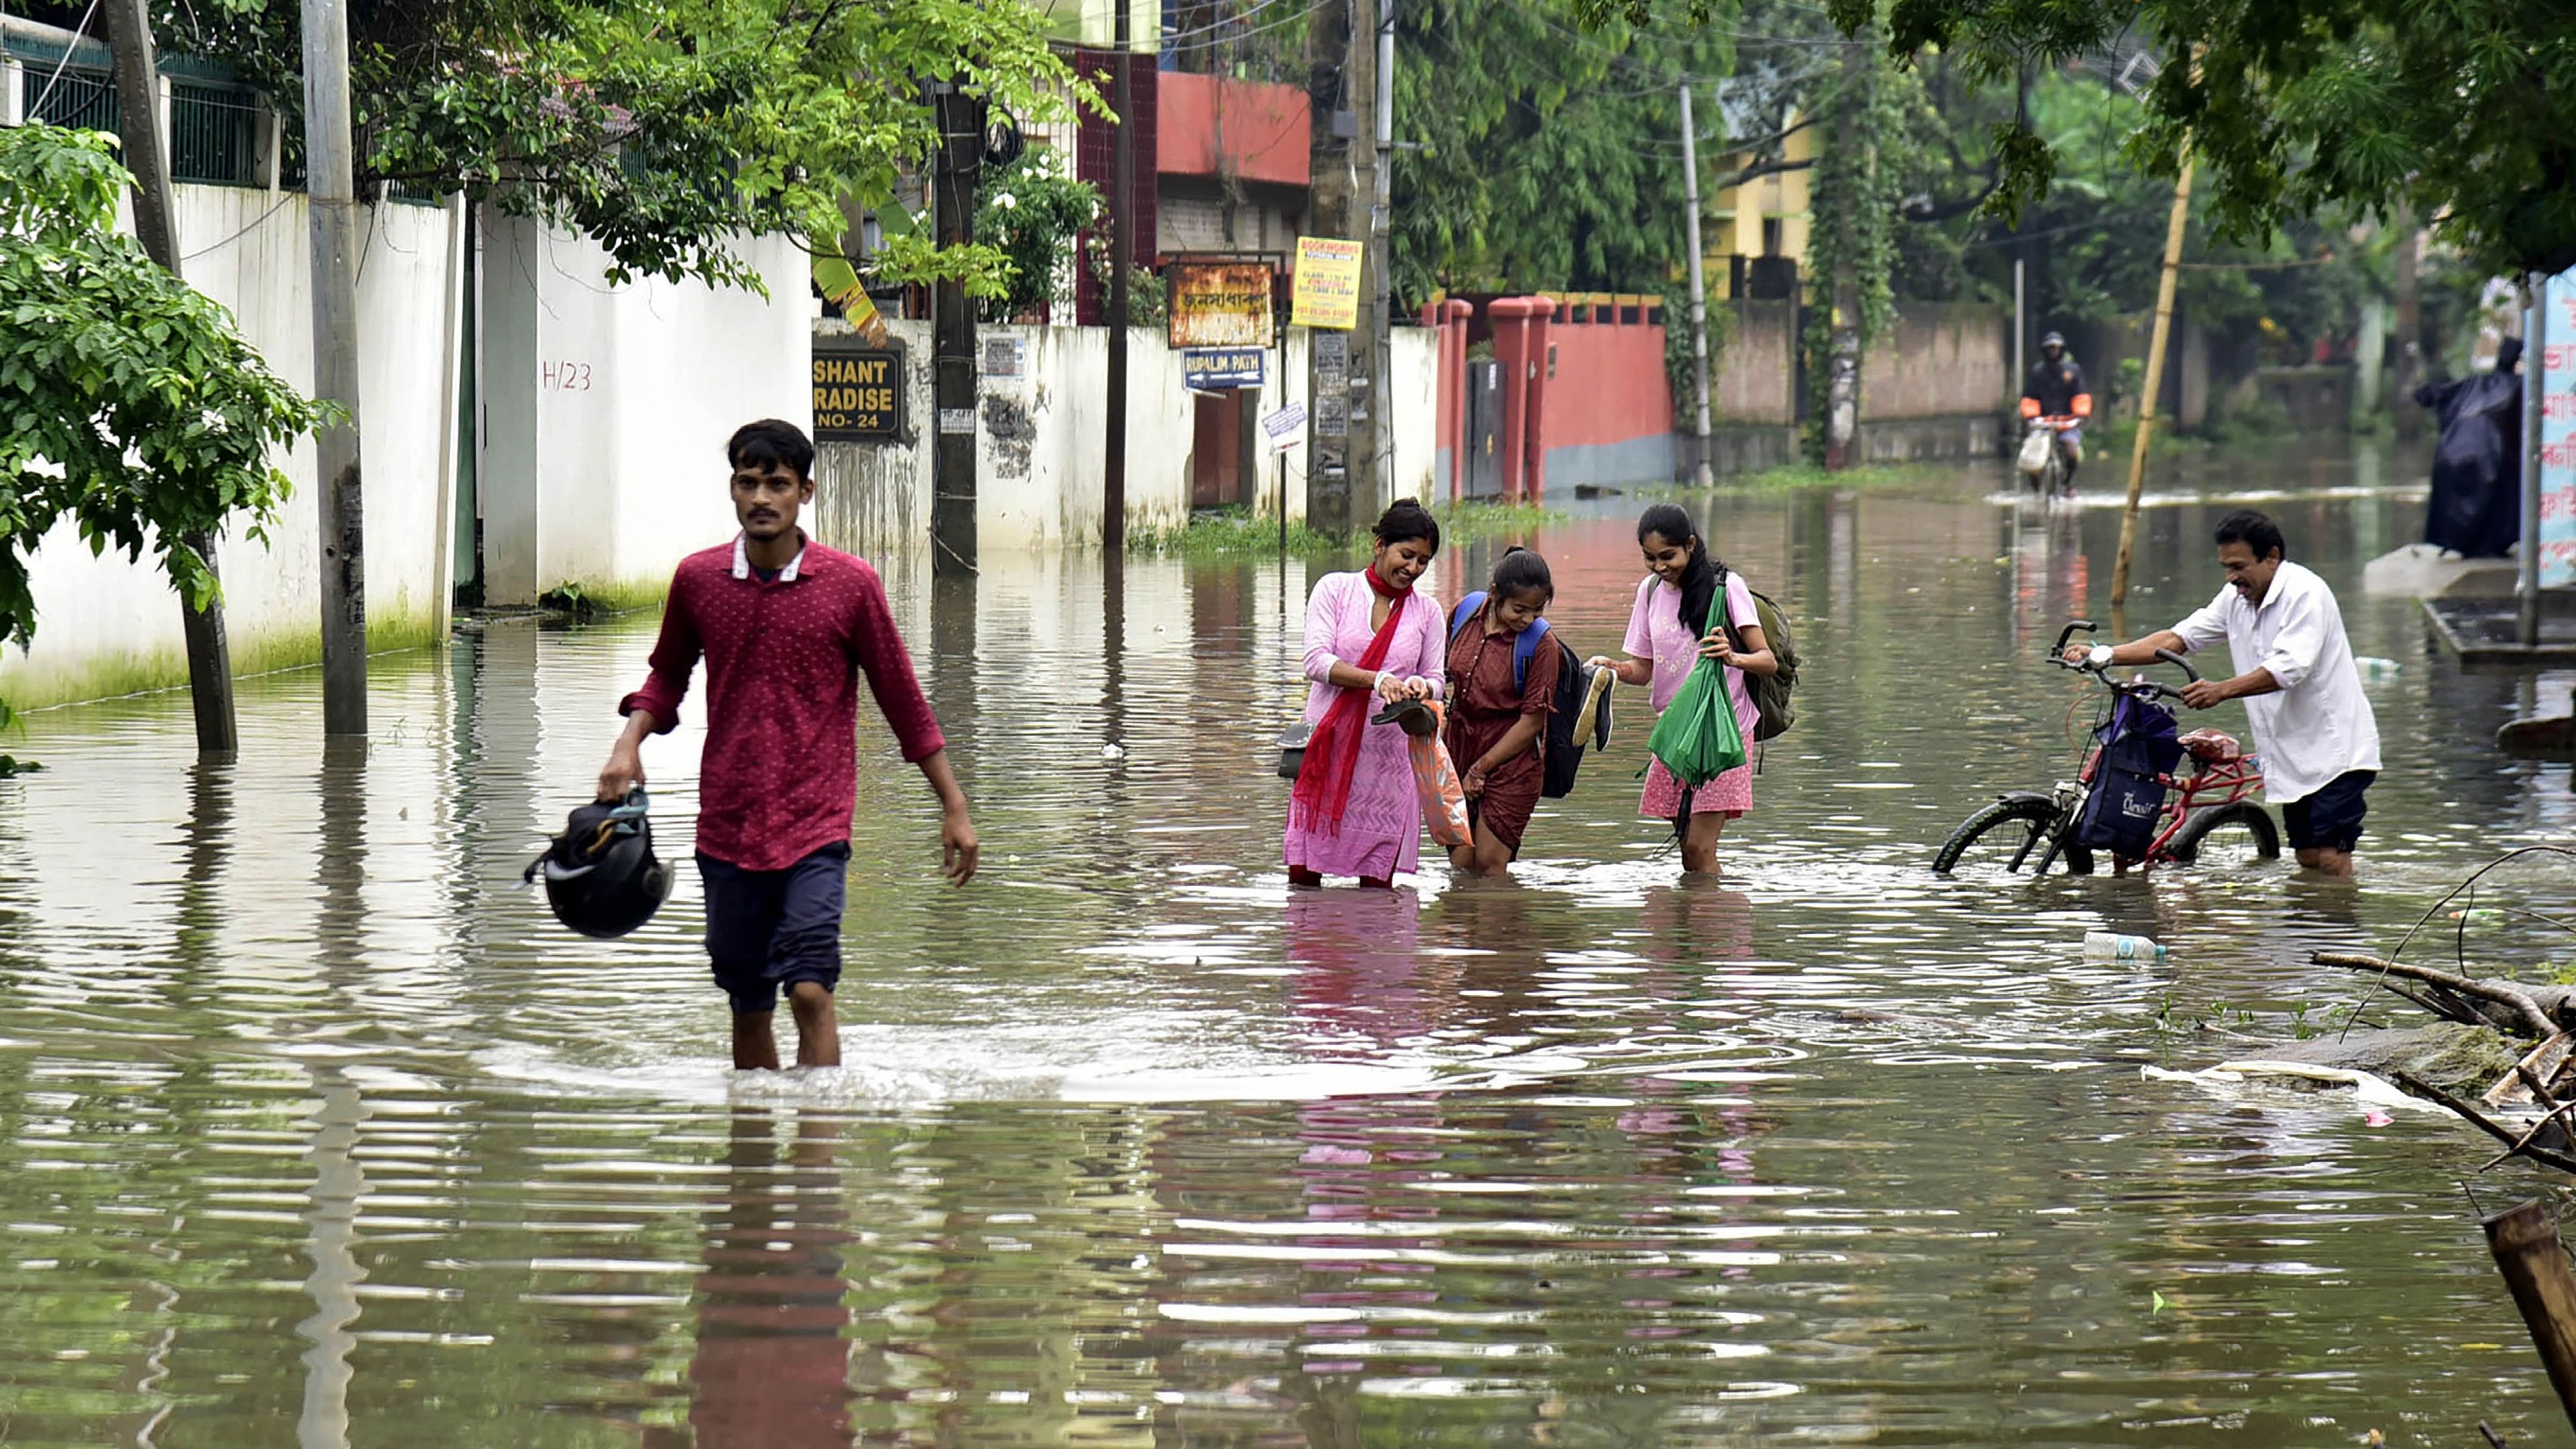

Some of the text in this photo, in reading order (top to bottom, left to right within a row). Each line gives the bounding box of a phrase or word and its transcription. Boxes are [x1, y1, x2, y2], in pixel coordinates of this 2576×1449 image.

[813, 360, 887, 384] SHANT
[1186, 355, 1259, 372] RUPALIM PATH
[543, 361, 591, 391] H/23
[813, 388, 892, 411] RADISE
[858, 414, 879, 428] 24
